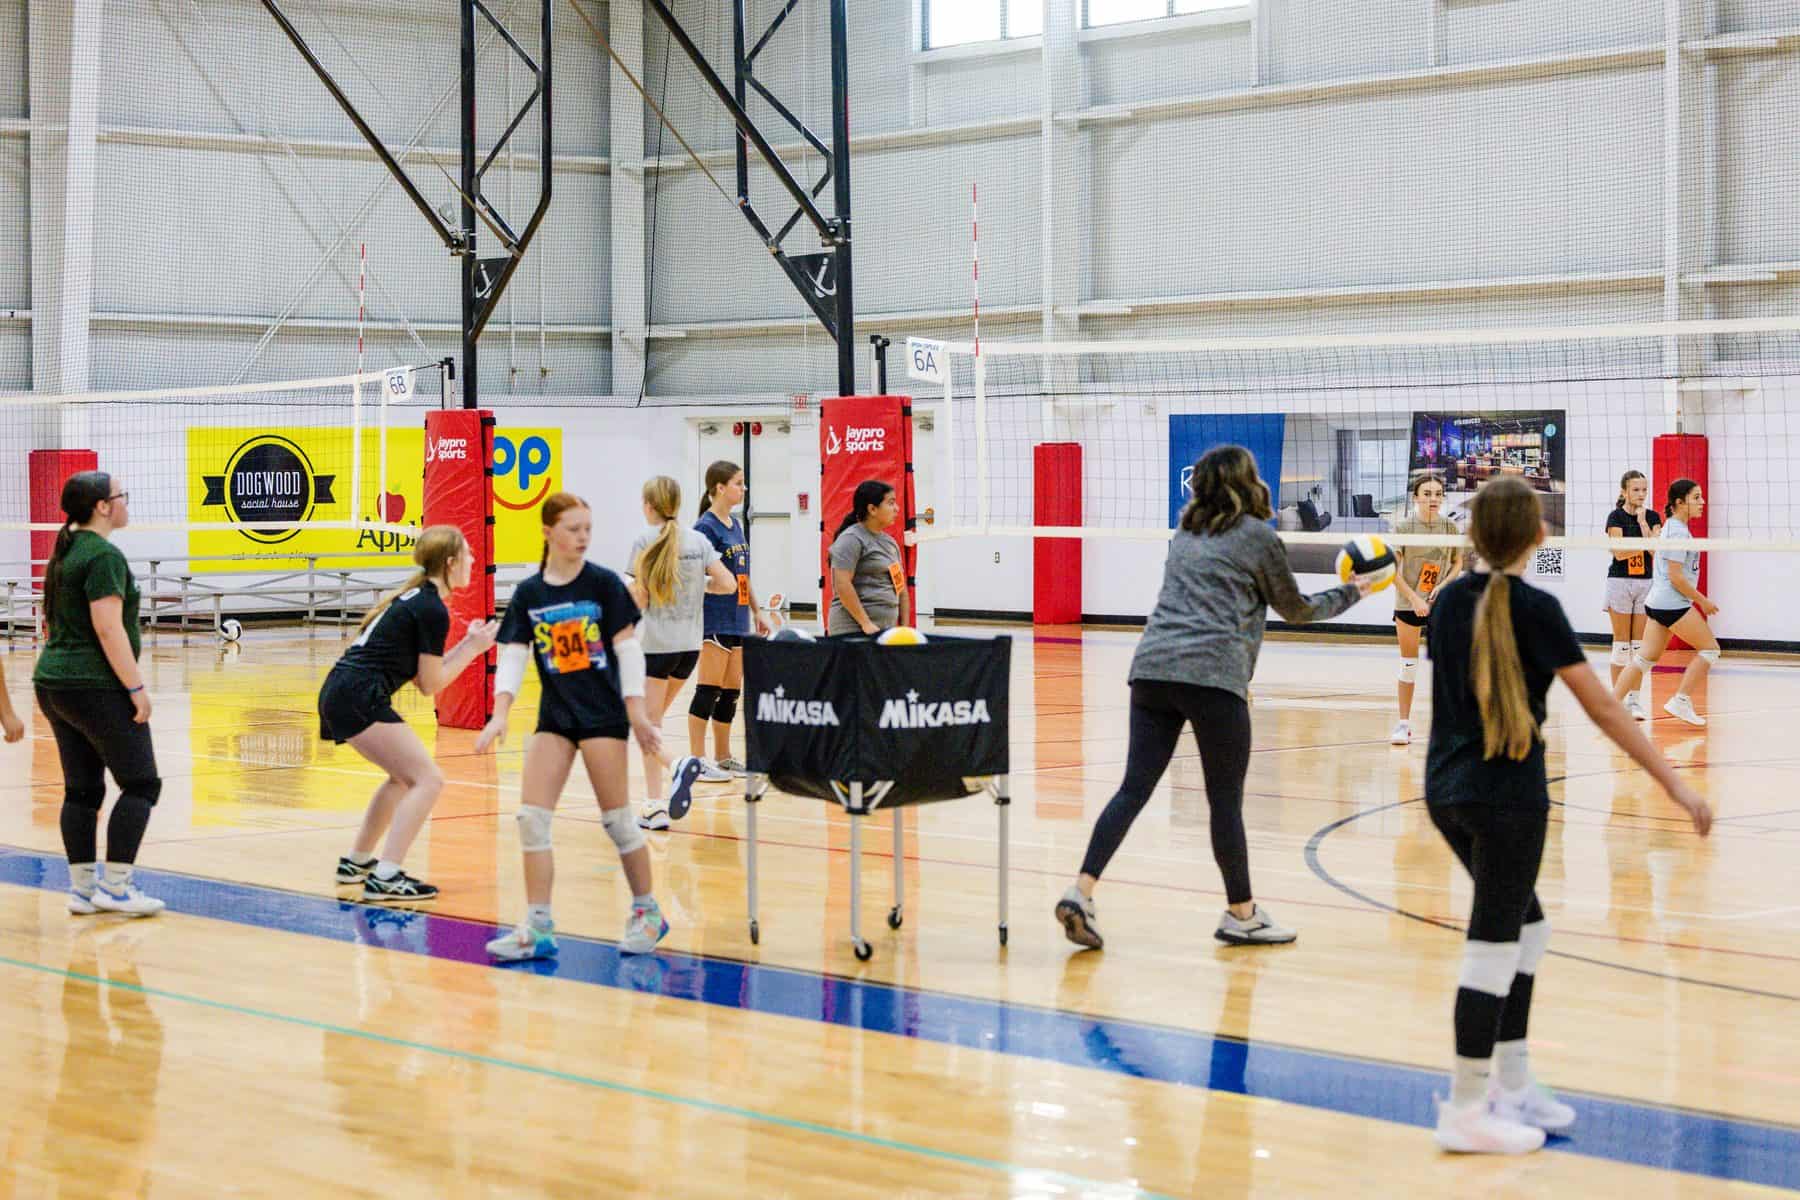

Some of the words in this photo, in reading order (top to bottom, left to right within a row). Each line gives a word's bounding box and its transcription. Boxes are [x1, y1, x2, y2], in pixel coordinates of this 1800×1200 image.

[913, 349, 938, 375] 6A
[388, 375, 407, 395] 6B
[845, 424, 886, 442] jaypro
[438, 435, 467, 450] jaypro
[845, 439, 885, 455] sports
[438, 448, 466, 462] sports
[236, 471, 301, 496] DOGWOOD
[240, 498, 270, 509] social
[271, 497, 300, 509] house
[1629, 555, 1643, 568] 33
[1423, 569, 1438, 585] 28
[557, 632, 584, 658] 34
[756, 692, 841, 727] MIKASA
[878, 699, 992, 729] MIKASA
